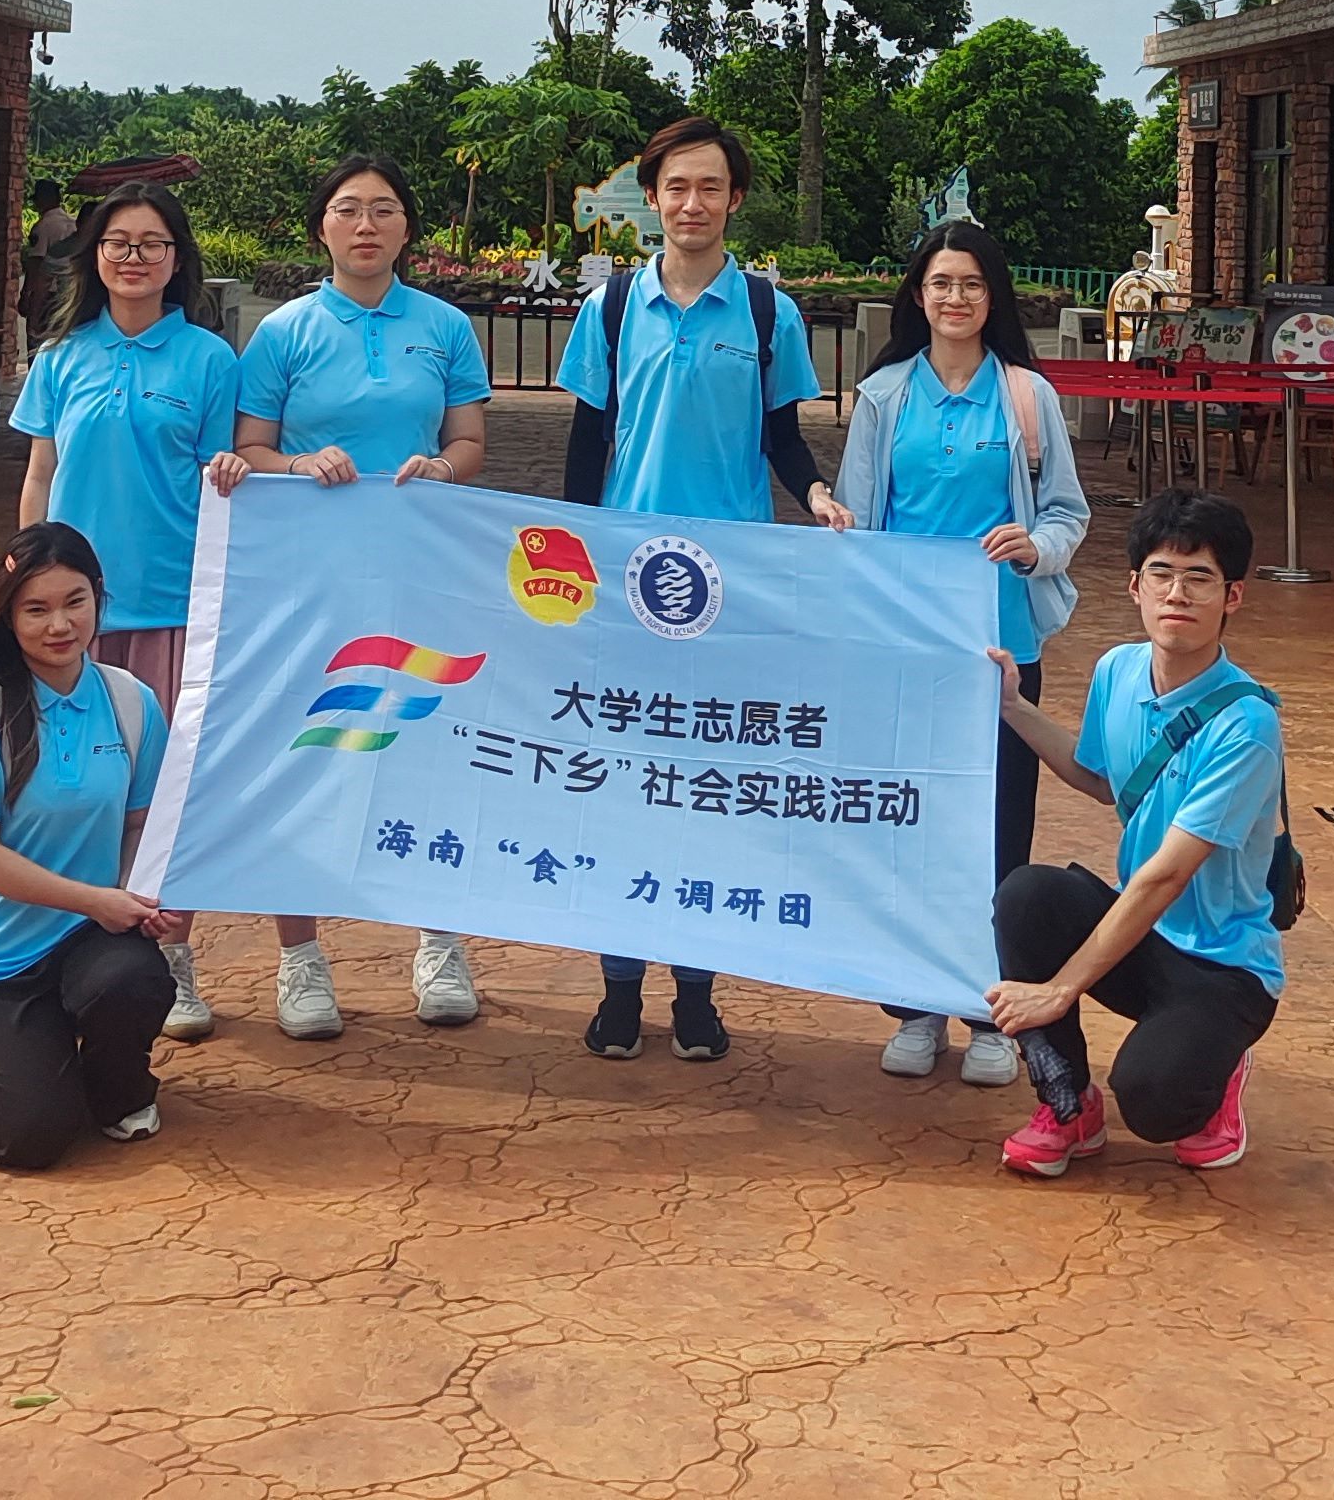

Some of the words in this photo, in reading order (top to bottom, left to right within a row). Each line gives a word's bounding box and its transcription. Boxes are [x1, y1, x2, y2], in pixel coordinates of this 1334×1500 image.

[628, 538, 720, 586] 海南热带海洋学院
[551, 682, 830, 750] 大学生志愿者
